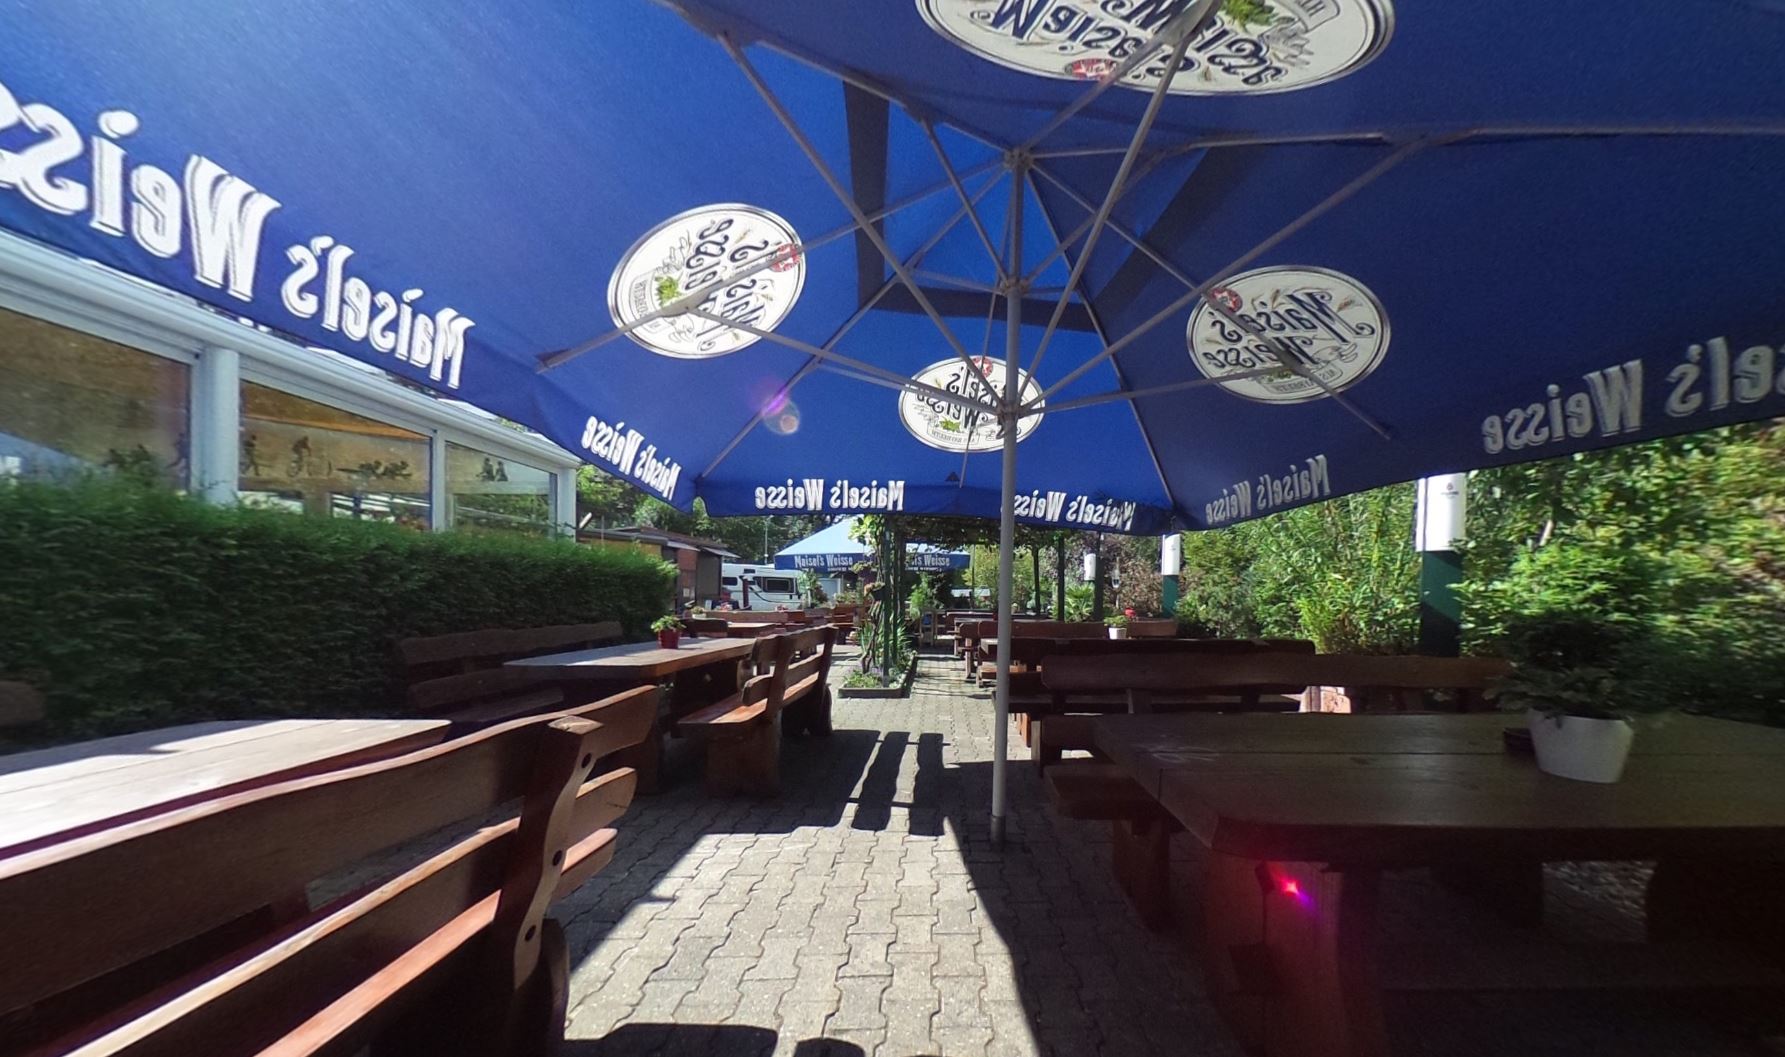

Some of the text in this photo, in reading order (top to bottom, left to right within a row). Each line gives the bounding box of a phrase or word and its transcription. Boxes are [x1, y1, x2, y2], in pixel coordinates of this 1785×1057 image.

[794, 553, 853, 569] Maisel's Weisse
[924, 554, 951, 567] Weisse
